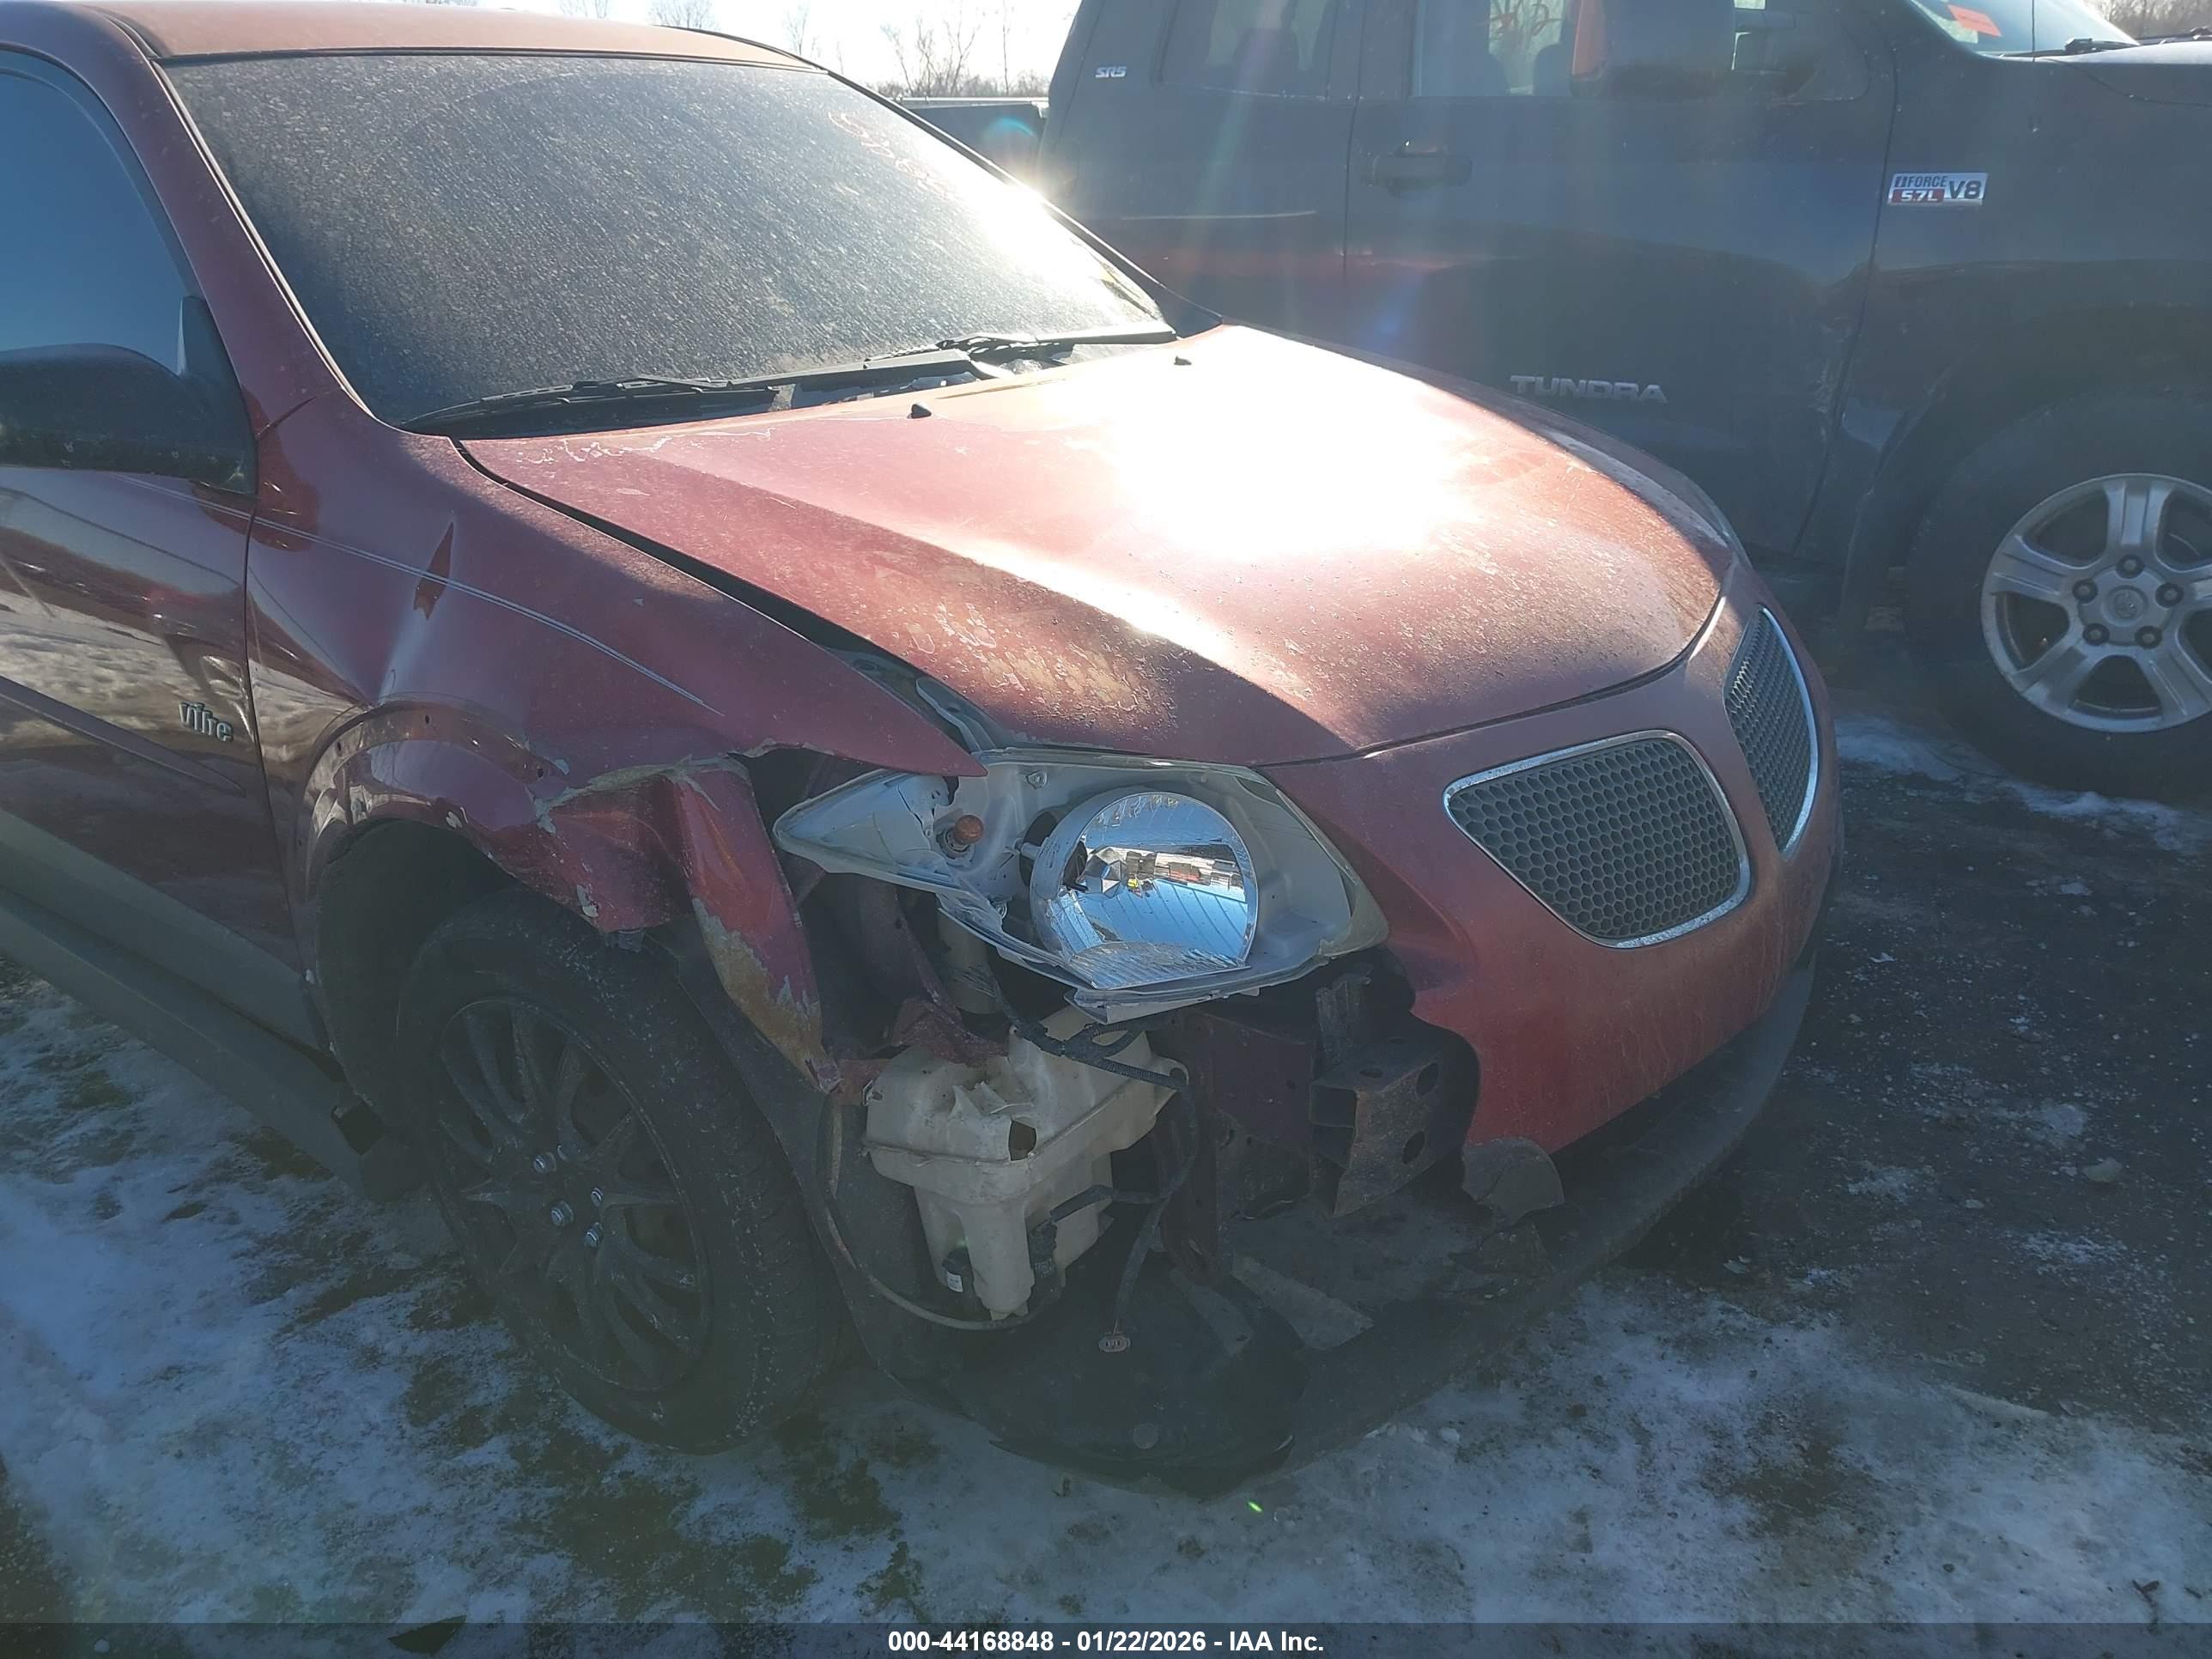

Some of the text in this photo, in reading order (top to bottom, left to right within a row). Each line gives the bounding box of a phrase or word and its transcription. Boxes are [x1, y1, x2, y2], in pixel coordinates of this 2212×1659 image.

[1096, 66, 1127, 78] SR5
[1901, 190, 1938, 202] 5.7L
[1948, 179, 1982, 200] V8
[1510, 375, 1668, 404] TUNDRA
